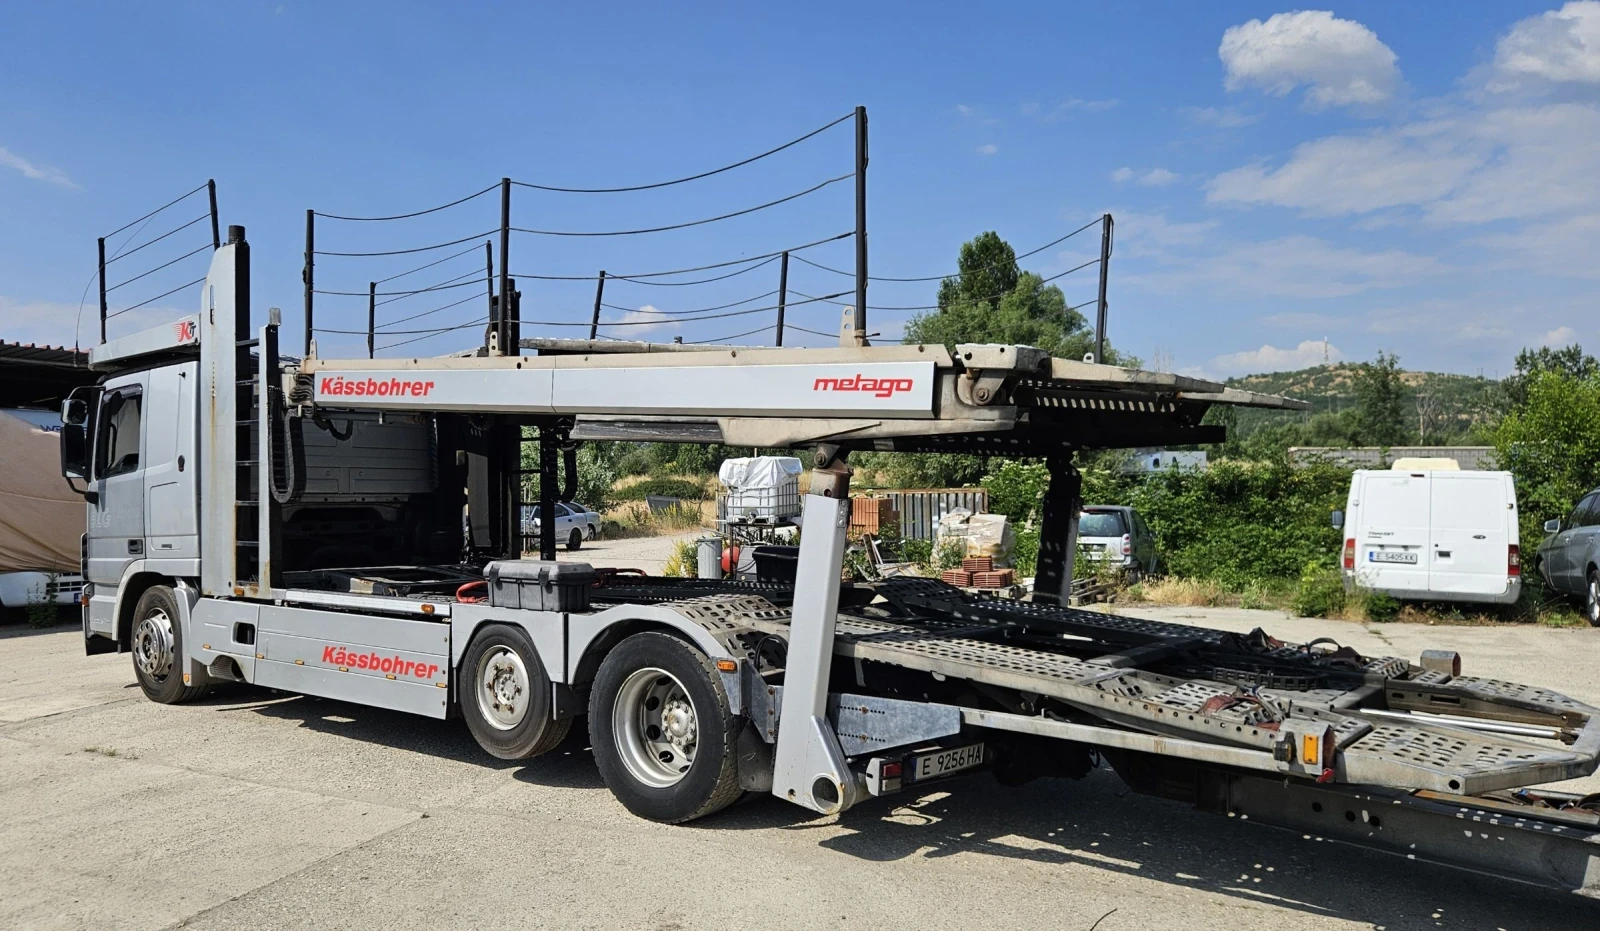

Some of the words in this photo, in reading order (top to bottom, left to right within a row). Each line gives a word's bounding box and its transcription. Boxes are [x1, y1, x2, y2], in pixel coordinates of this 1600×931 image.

[320, 376, 435, 396] Kässbohrer
[813, 373, 914, 398] metago
[1376, 552, 1383, 560] E
[1385, 552, 1404, 561] 5405
[1404, 554, 1415, 562] KK
[322, 645, 438, 679] Kässbohrer
[922, 757, 932, 776] E
[937, 749, 965, 773] 9256
[966, 745, 982, 765] HA
